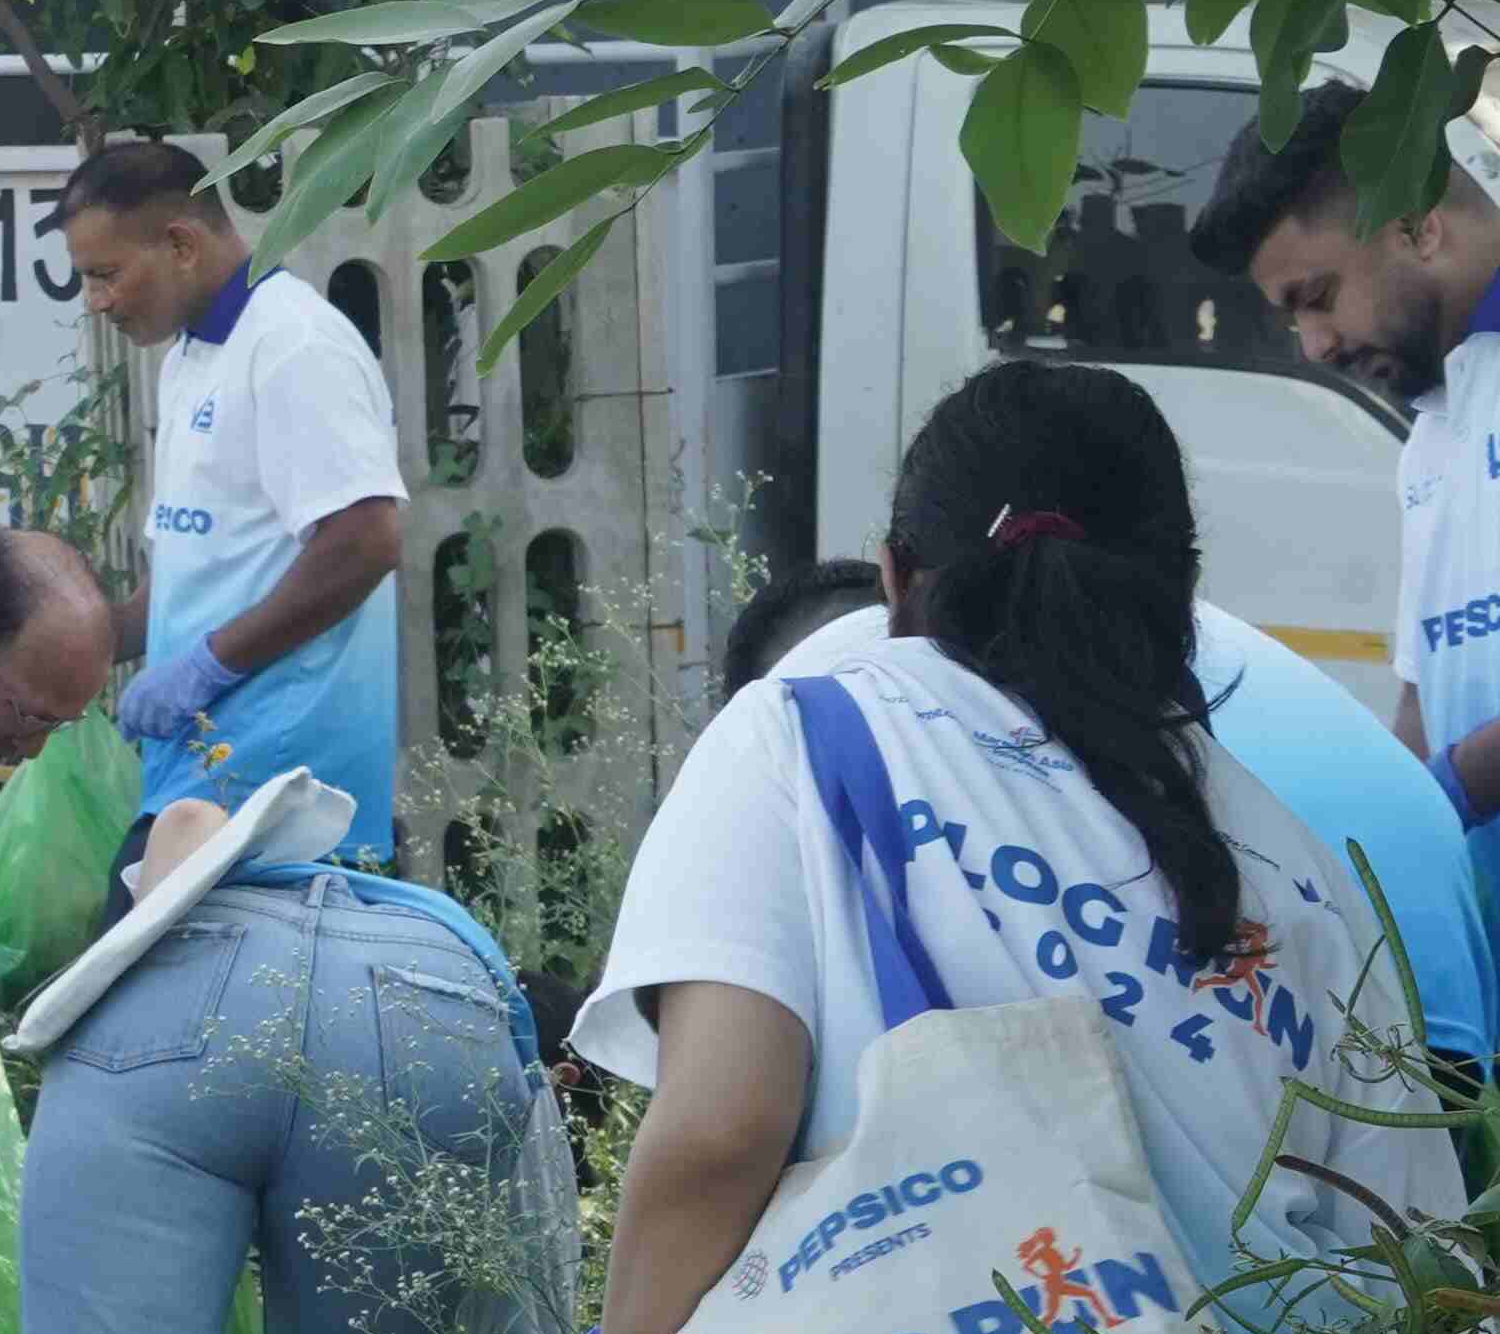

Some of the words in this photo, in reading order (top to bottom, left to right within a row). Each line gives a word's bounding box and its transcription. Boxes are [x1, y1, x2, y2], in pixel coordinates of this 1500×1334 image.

[982, 907, 1217, 1064] 024
[778, 1159, 984, 1294] PEPSICO
[829, 1222, 933, 1282] PRESENTS
